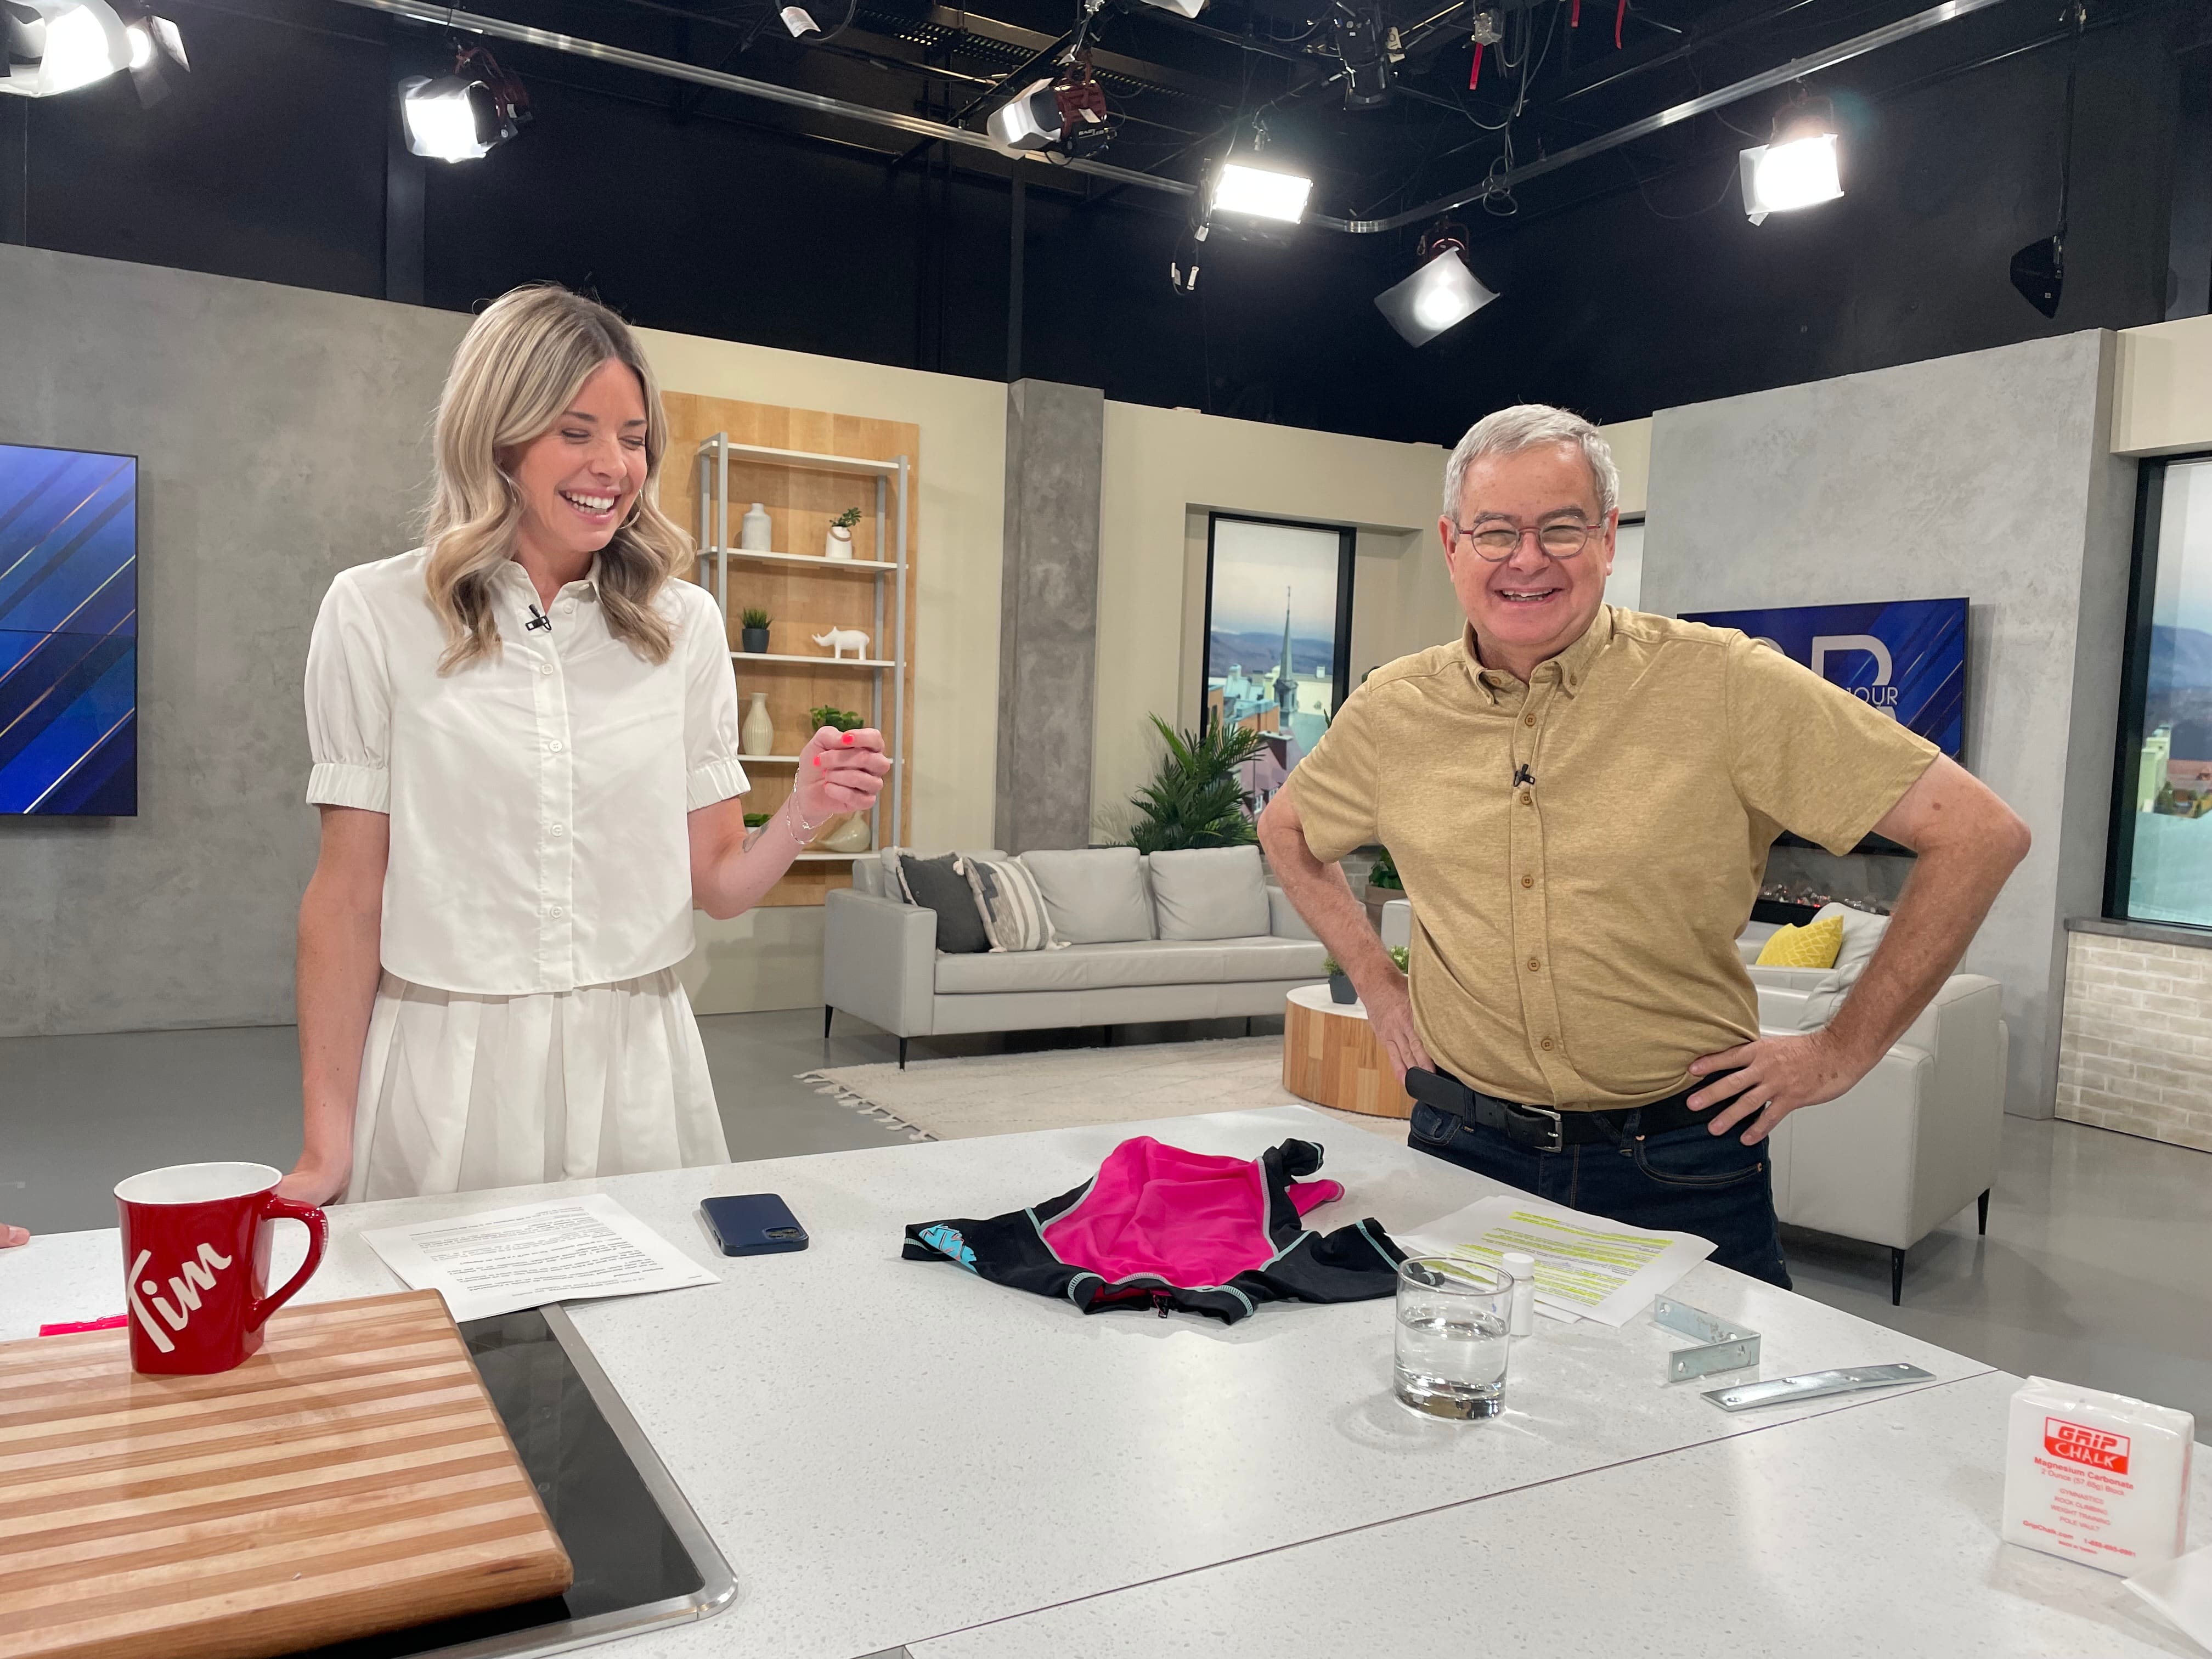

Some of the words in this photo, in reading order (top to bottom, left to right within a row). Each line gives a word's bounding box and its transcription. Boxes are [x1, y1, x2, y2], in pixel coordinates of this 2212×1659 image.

[128, 1243, 232, 1353] Tim
[2055, 1442, 2119, 1470] CHALK
[2034, 1457, 2085, 1476] Magnesium
[2087, 1471, 2134, 1490] Carbonate
[2047, 1470, 2072, 1482] Ounce
[2059, 1488, 2104, 1504] GYMNASTICS
